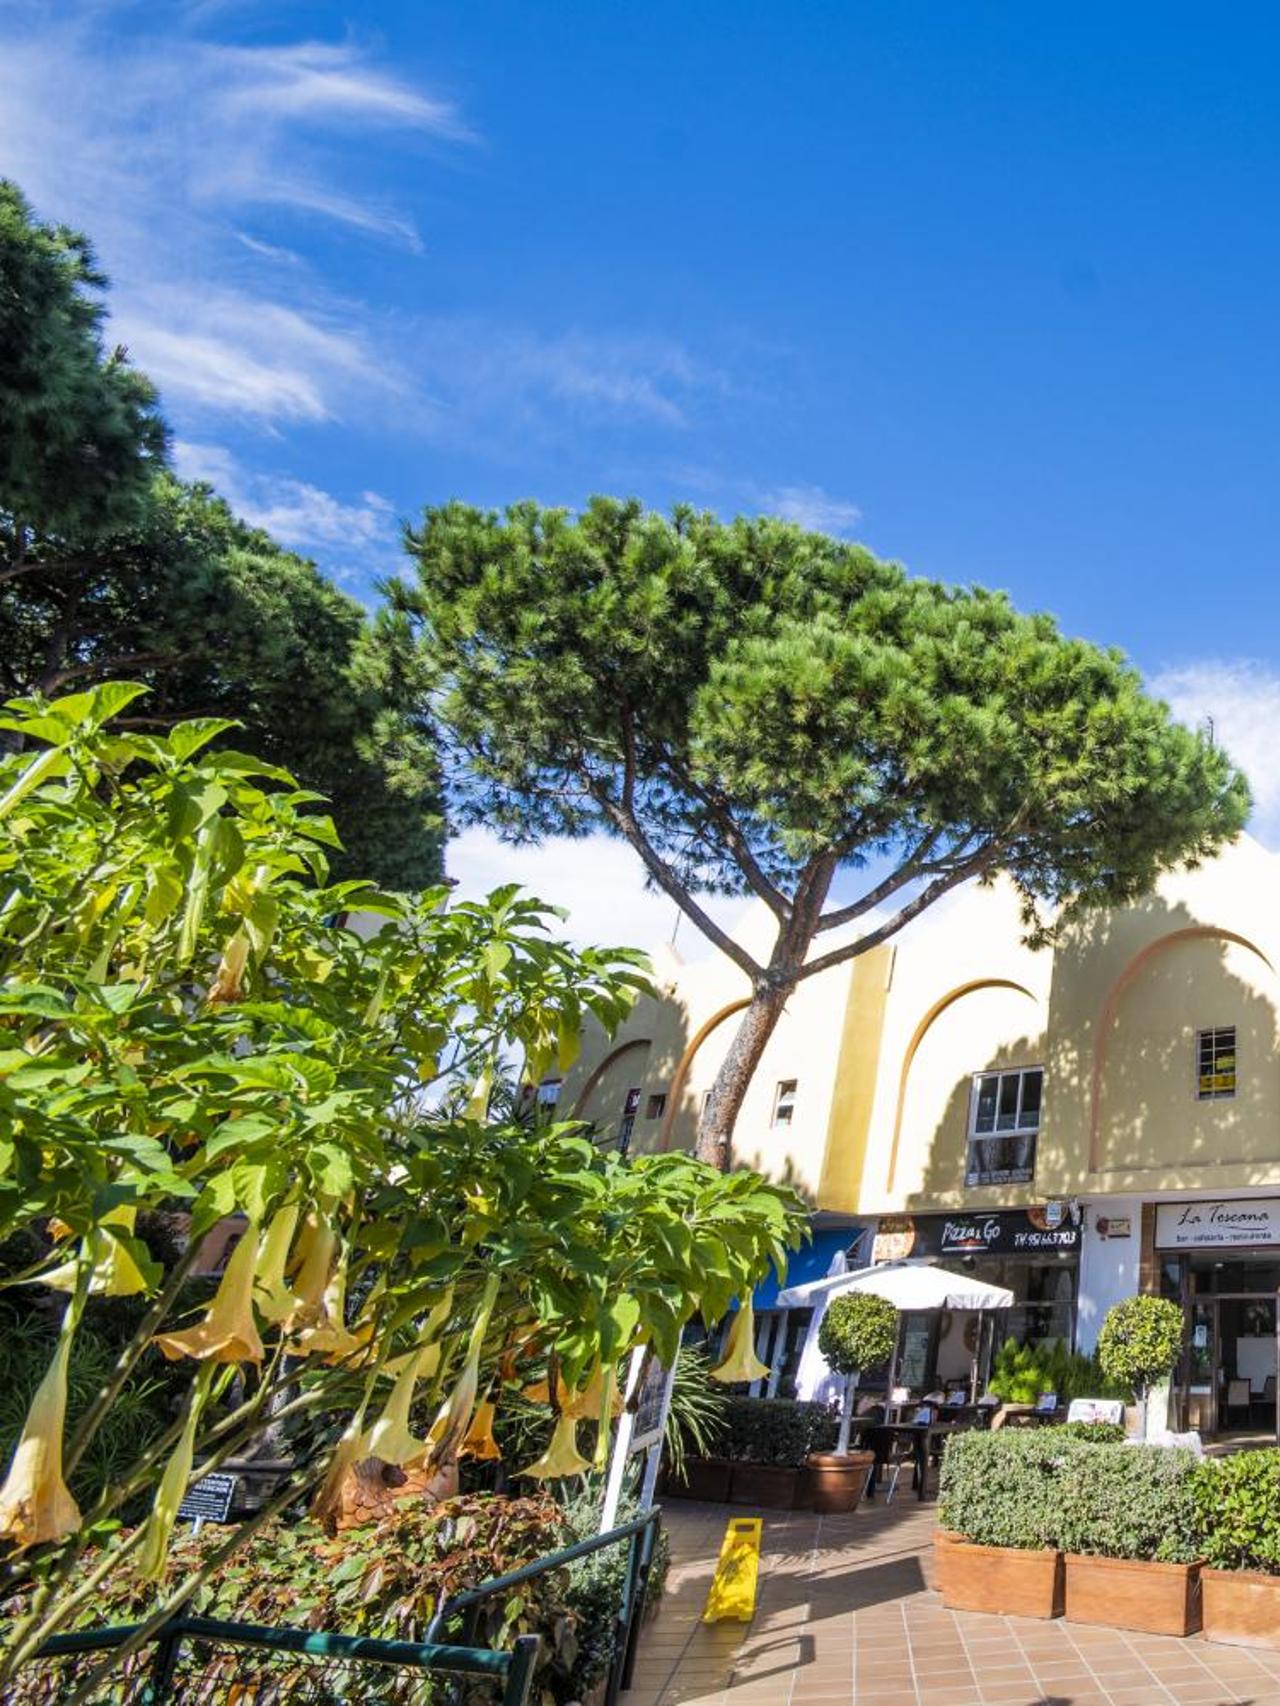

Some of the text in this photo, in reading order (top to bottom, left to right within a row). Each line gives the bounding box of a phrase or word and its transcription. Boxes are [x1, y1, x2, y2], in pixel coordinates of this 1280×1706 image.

[1177, 1204, 1269, 1226] La Toscana
[941, 1221, 975, 1245] Pizza
[983, 1219, 1000, 1245] Go
